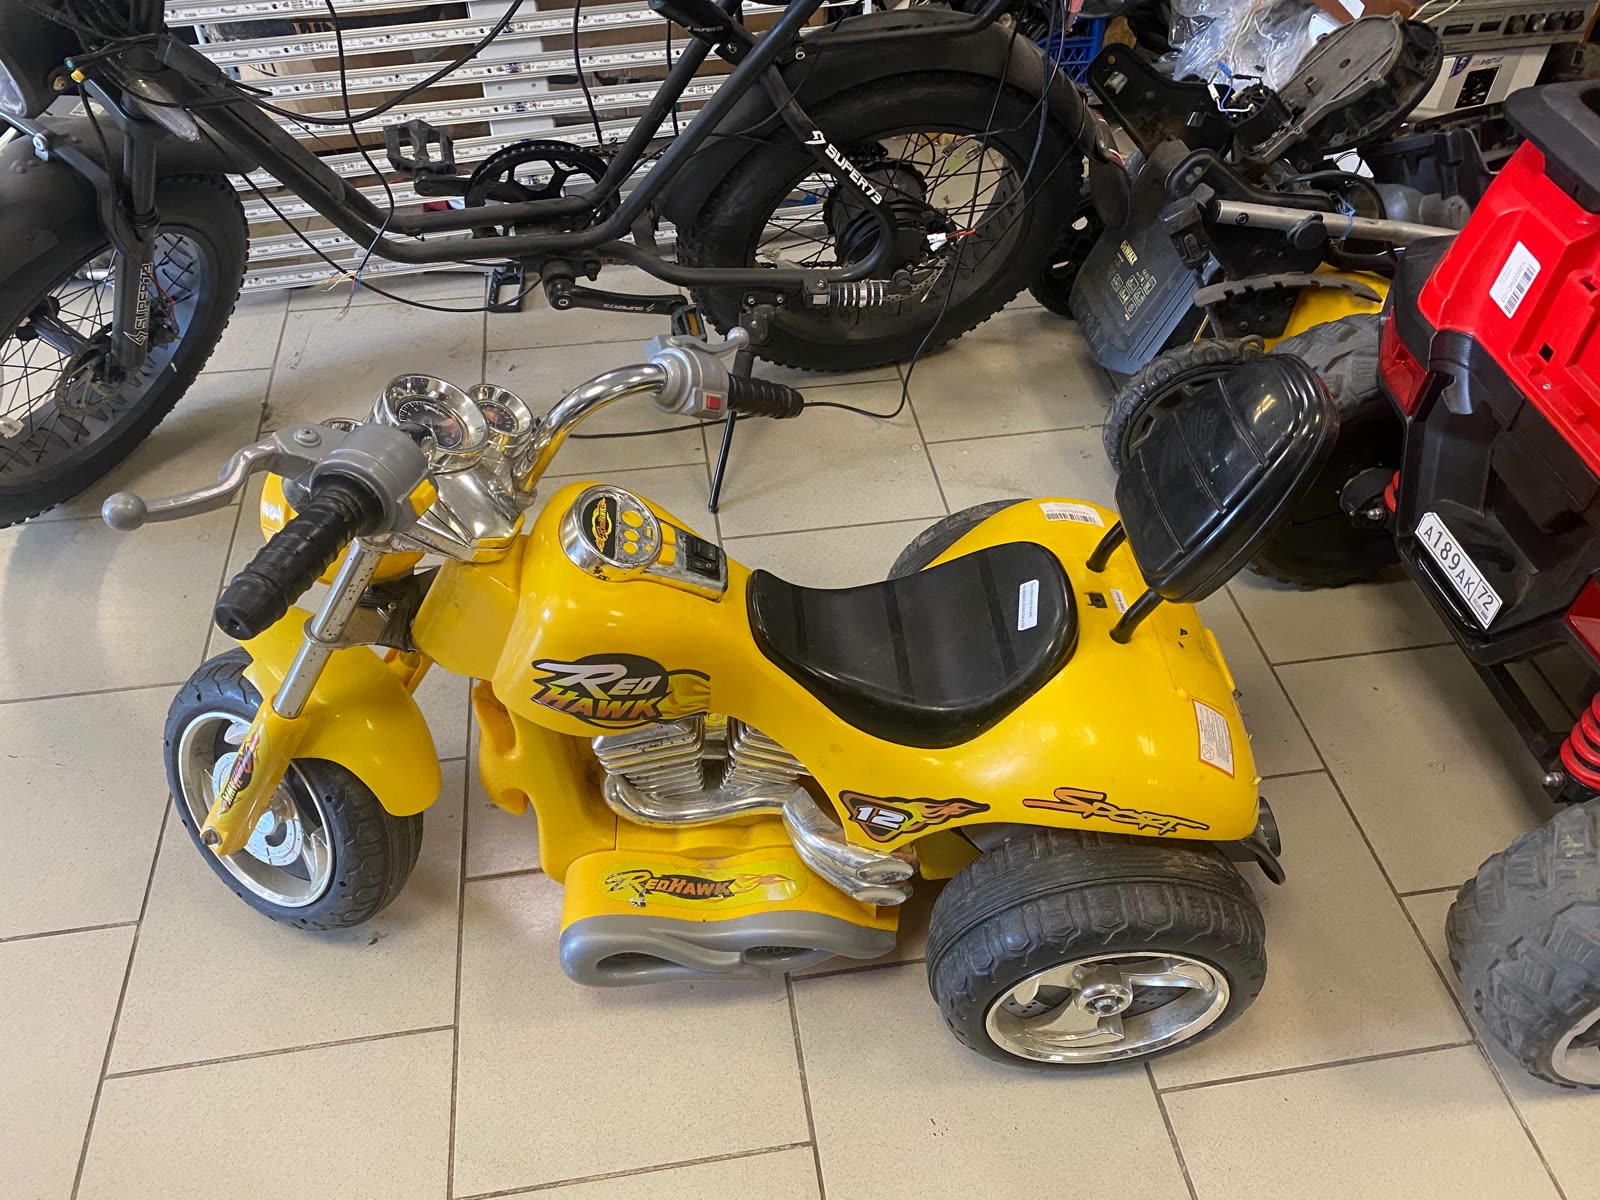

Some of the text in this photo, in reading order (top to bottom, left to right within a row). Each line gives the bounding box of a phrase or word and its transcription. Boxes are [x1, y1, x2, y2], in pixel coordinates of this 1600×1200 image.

[825, 143, 883, 205] SUPER73
[1477, 585, 1495, 612] 72
[538, 682, 662, 719] HAWK
[856, 806, 905, 830] 12
